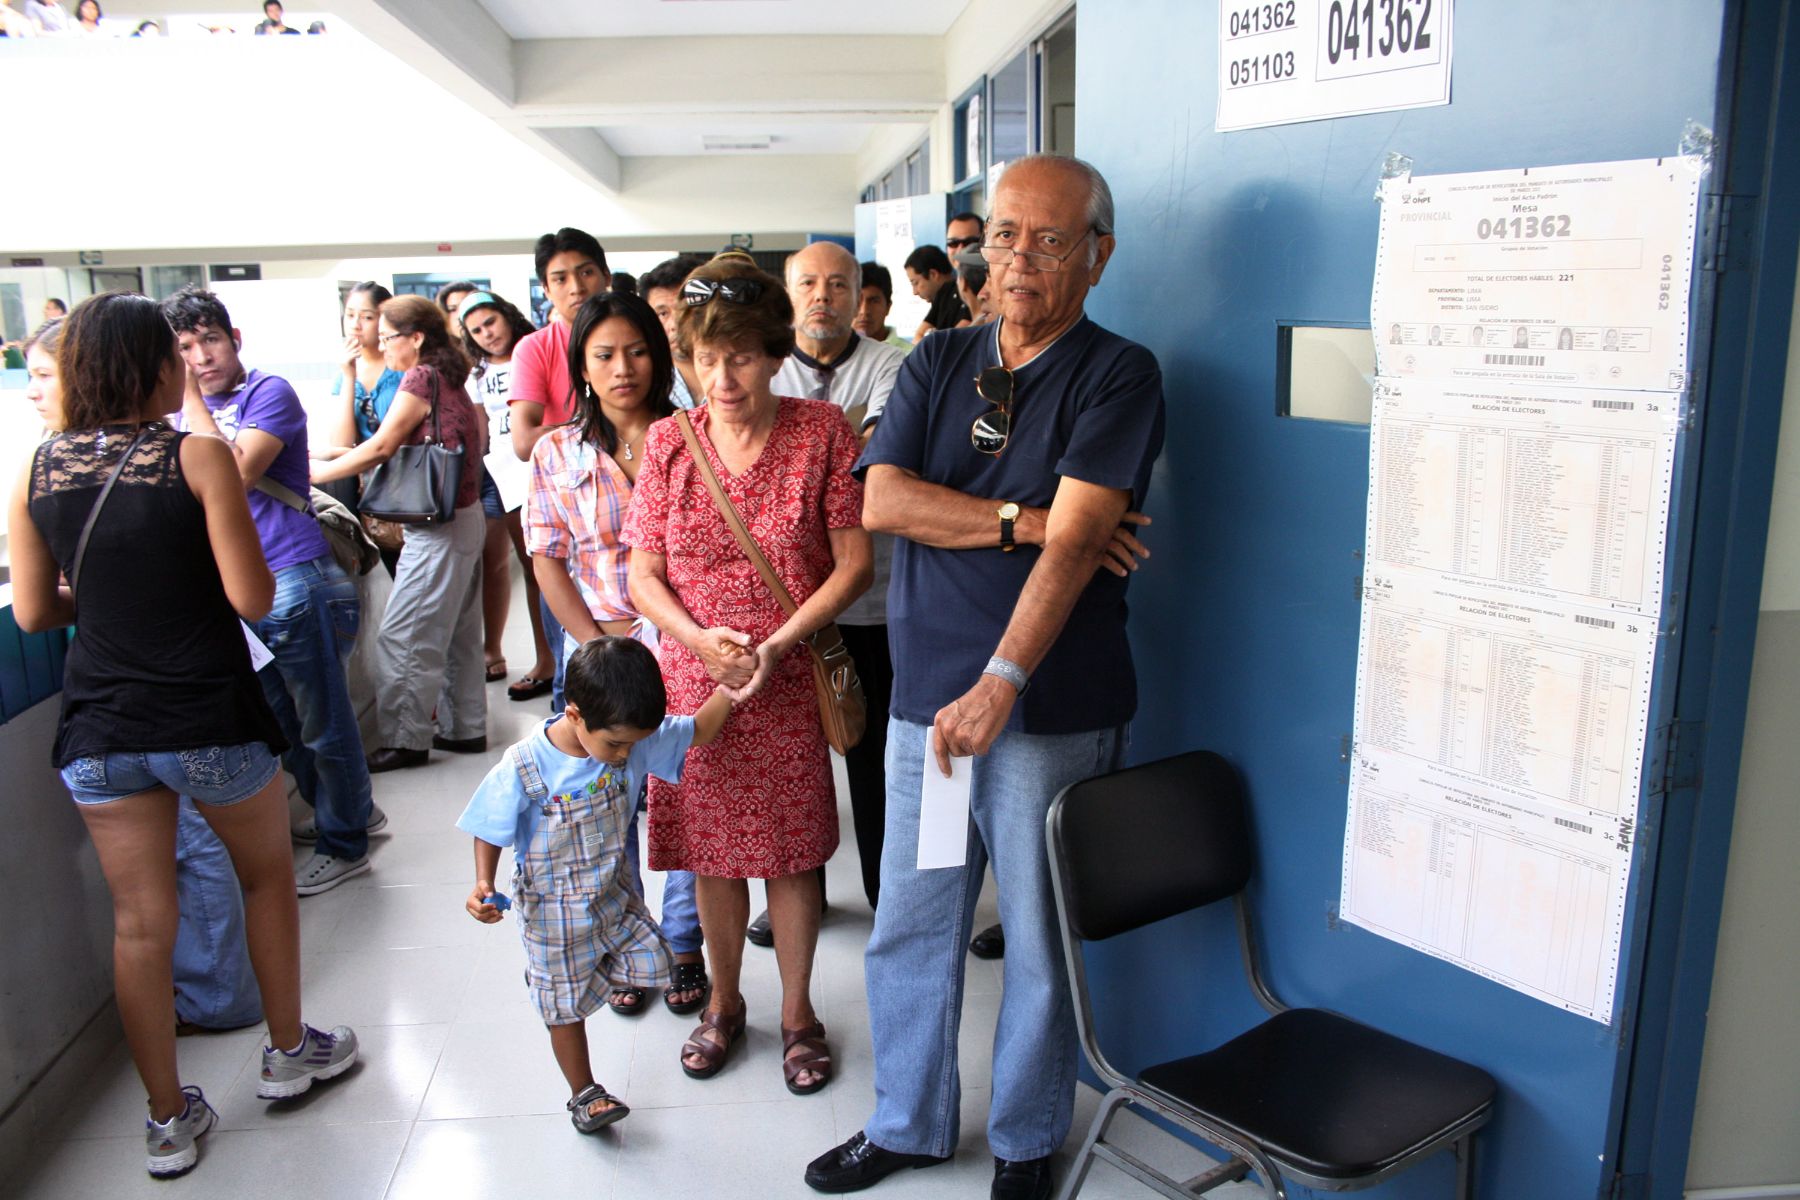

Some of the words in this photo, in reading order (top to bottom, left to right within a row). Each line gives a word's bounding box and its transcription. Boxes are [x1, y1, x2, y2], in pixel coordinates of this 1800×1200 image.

[1230, 0, 1295, 37] 041362
[1327, 0, 1432, 65] 041362
[1230, 51, 1295, 86] 051103
[1669, 174, 1674, 182] 1
[1512, 204, 1538, 213] Mesa
[1400, 211, 1452, 222] PROVINCIAL
[1477, 214, 1571, 240] 041362
[1657, 254, 1673, 310] 041362
[1512, 407, 1546, 415] ELECTORES
[1647, 403, 1659, 412] 3a
[1498, 612, 1531, 623] ELECTORES
[1626, 624, 1638, 633] 3b
[1603, 832, 1615, 841] 3c
